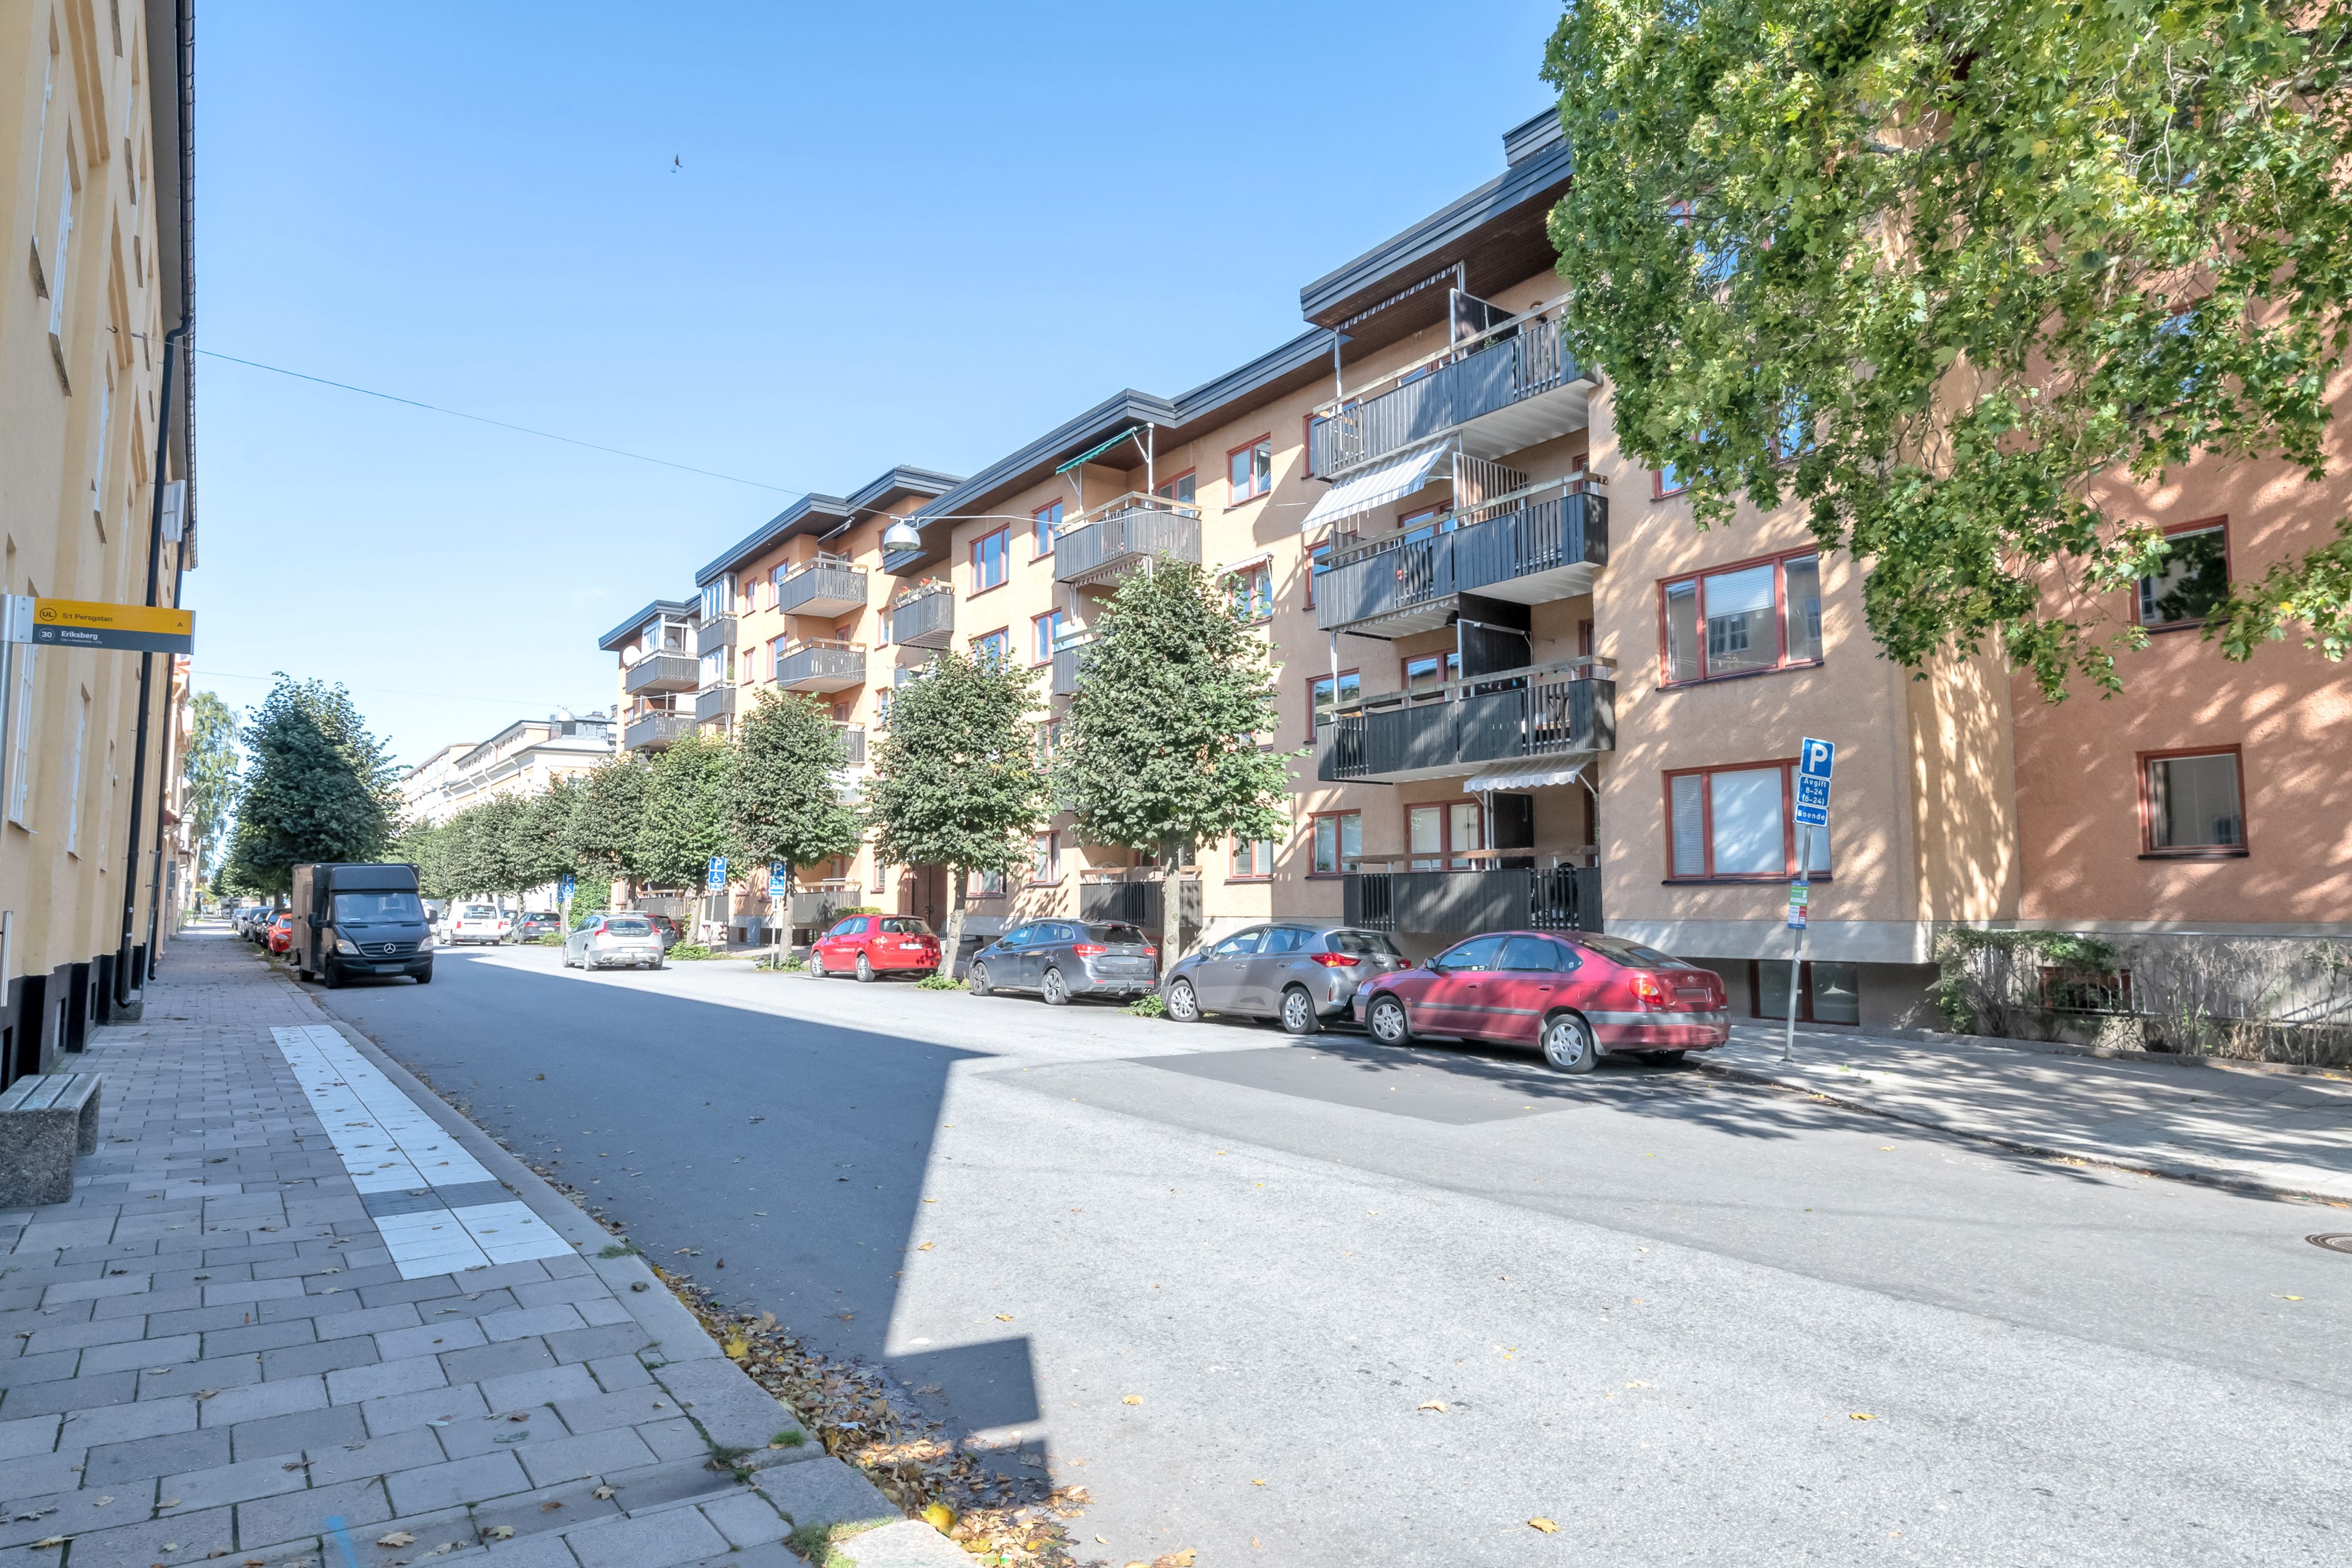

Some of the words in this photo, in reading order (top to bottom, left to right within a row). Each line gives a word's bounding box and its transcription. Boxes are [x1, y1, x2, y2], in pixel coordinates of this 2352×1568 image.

[74, 613, 113, 622] Persgatan
[62, 631, 98, 640] Eriksberg
[1809, 743, 1829, 772] P
[1803, 777, 1826, 788] Avgift
[1797, 809, 1825, 821] Boende
[714, 858, 723, 870] P
[774, 863, 783, 875] P
